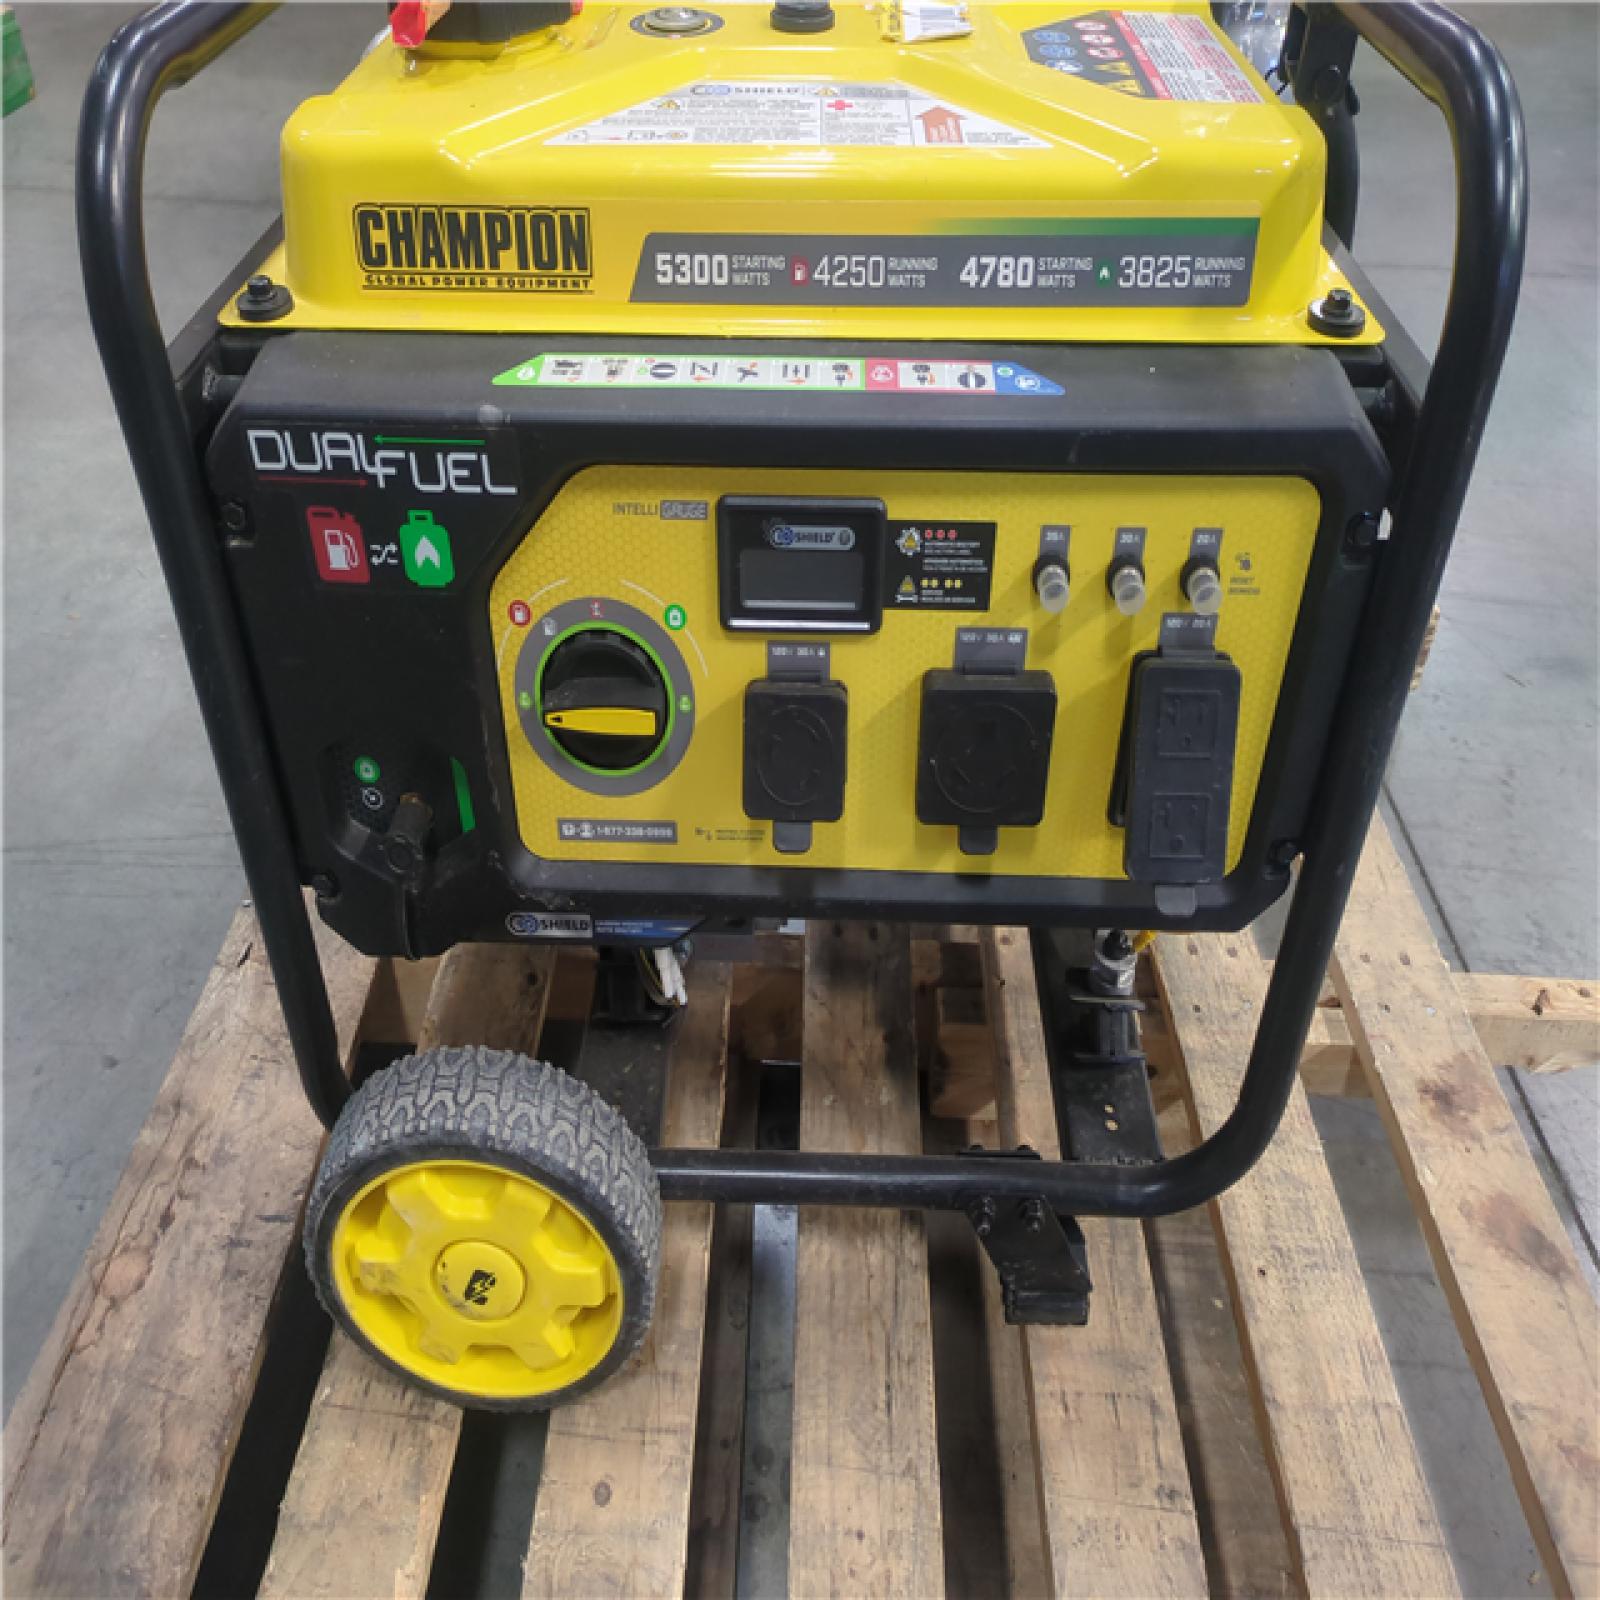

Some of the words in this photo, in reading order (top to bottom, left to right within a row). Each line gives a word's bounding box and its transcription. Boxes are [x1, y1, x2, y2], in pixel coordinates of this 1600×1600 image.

[359, 209, 588, 271] CHAMPION
[655, 253, 729, 286] 5300
[732, 255, 786, 270] STARTING
[813, 255, 886, 287] 4250
[887, 257, 939, 271] RUNNING
[959, 256, 1034, 289] 4780
[1036, 257, 1093, 271] STARTING
[1118, 256, 1191, 288] 3825
[1193, 257, 1246, 271] RUNNING
[364, 274, 426, 286] GLOBAL
[432, 276, 488, 287] POWER
[497, 277, 591, 289] EQUIPMENT
[732, 272, 770, 286] WATTS
[887, 274, 926, 288] WATTS
[1037, 274, 1076, 288] WATTS
[1193, 274, 1232, 288] WATTS
[247, 429, 380, 473] DUAL
[373, 450, 517, 494] FUEL
[661, 503, 706, 519] GAUGE
[795, 531, 834, 544] SHIELD
[539, 919, 589, 931] SHIELD
